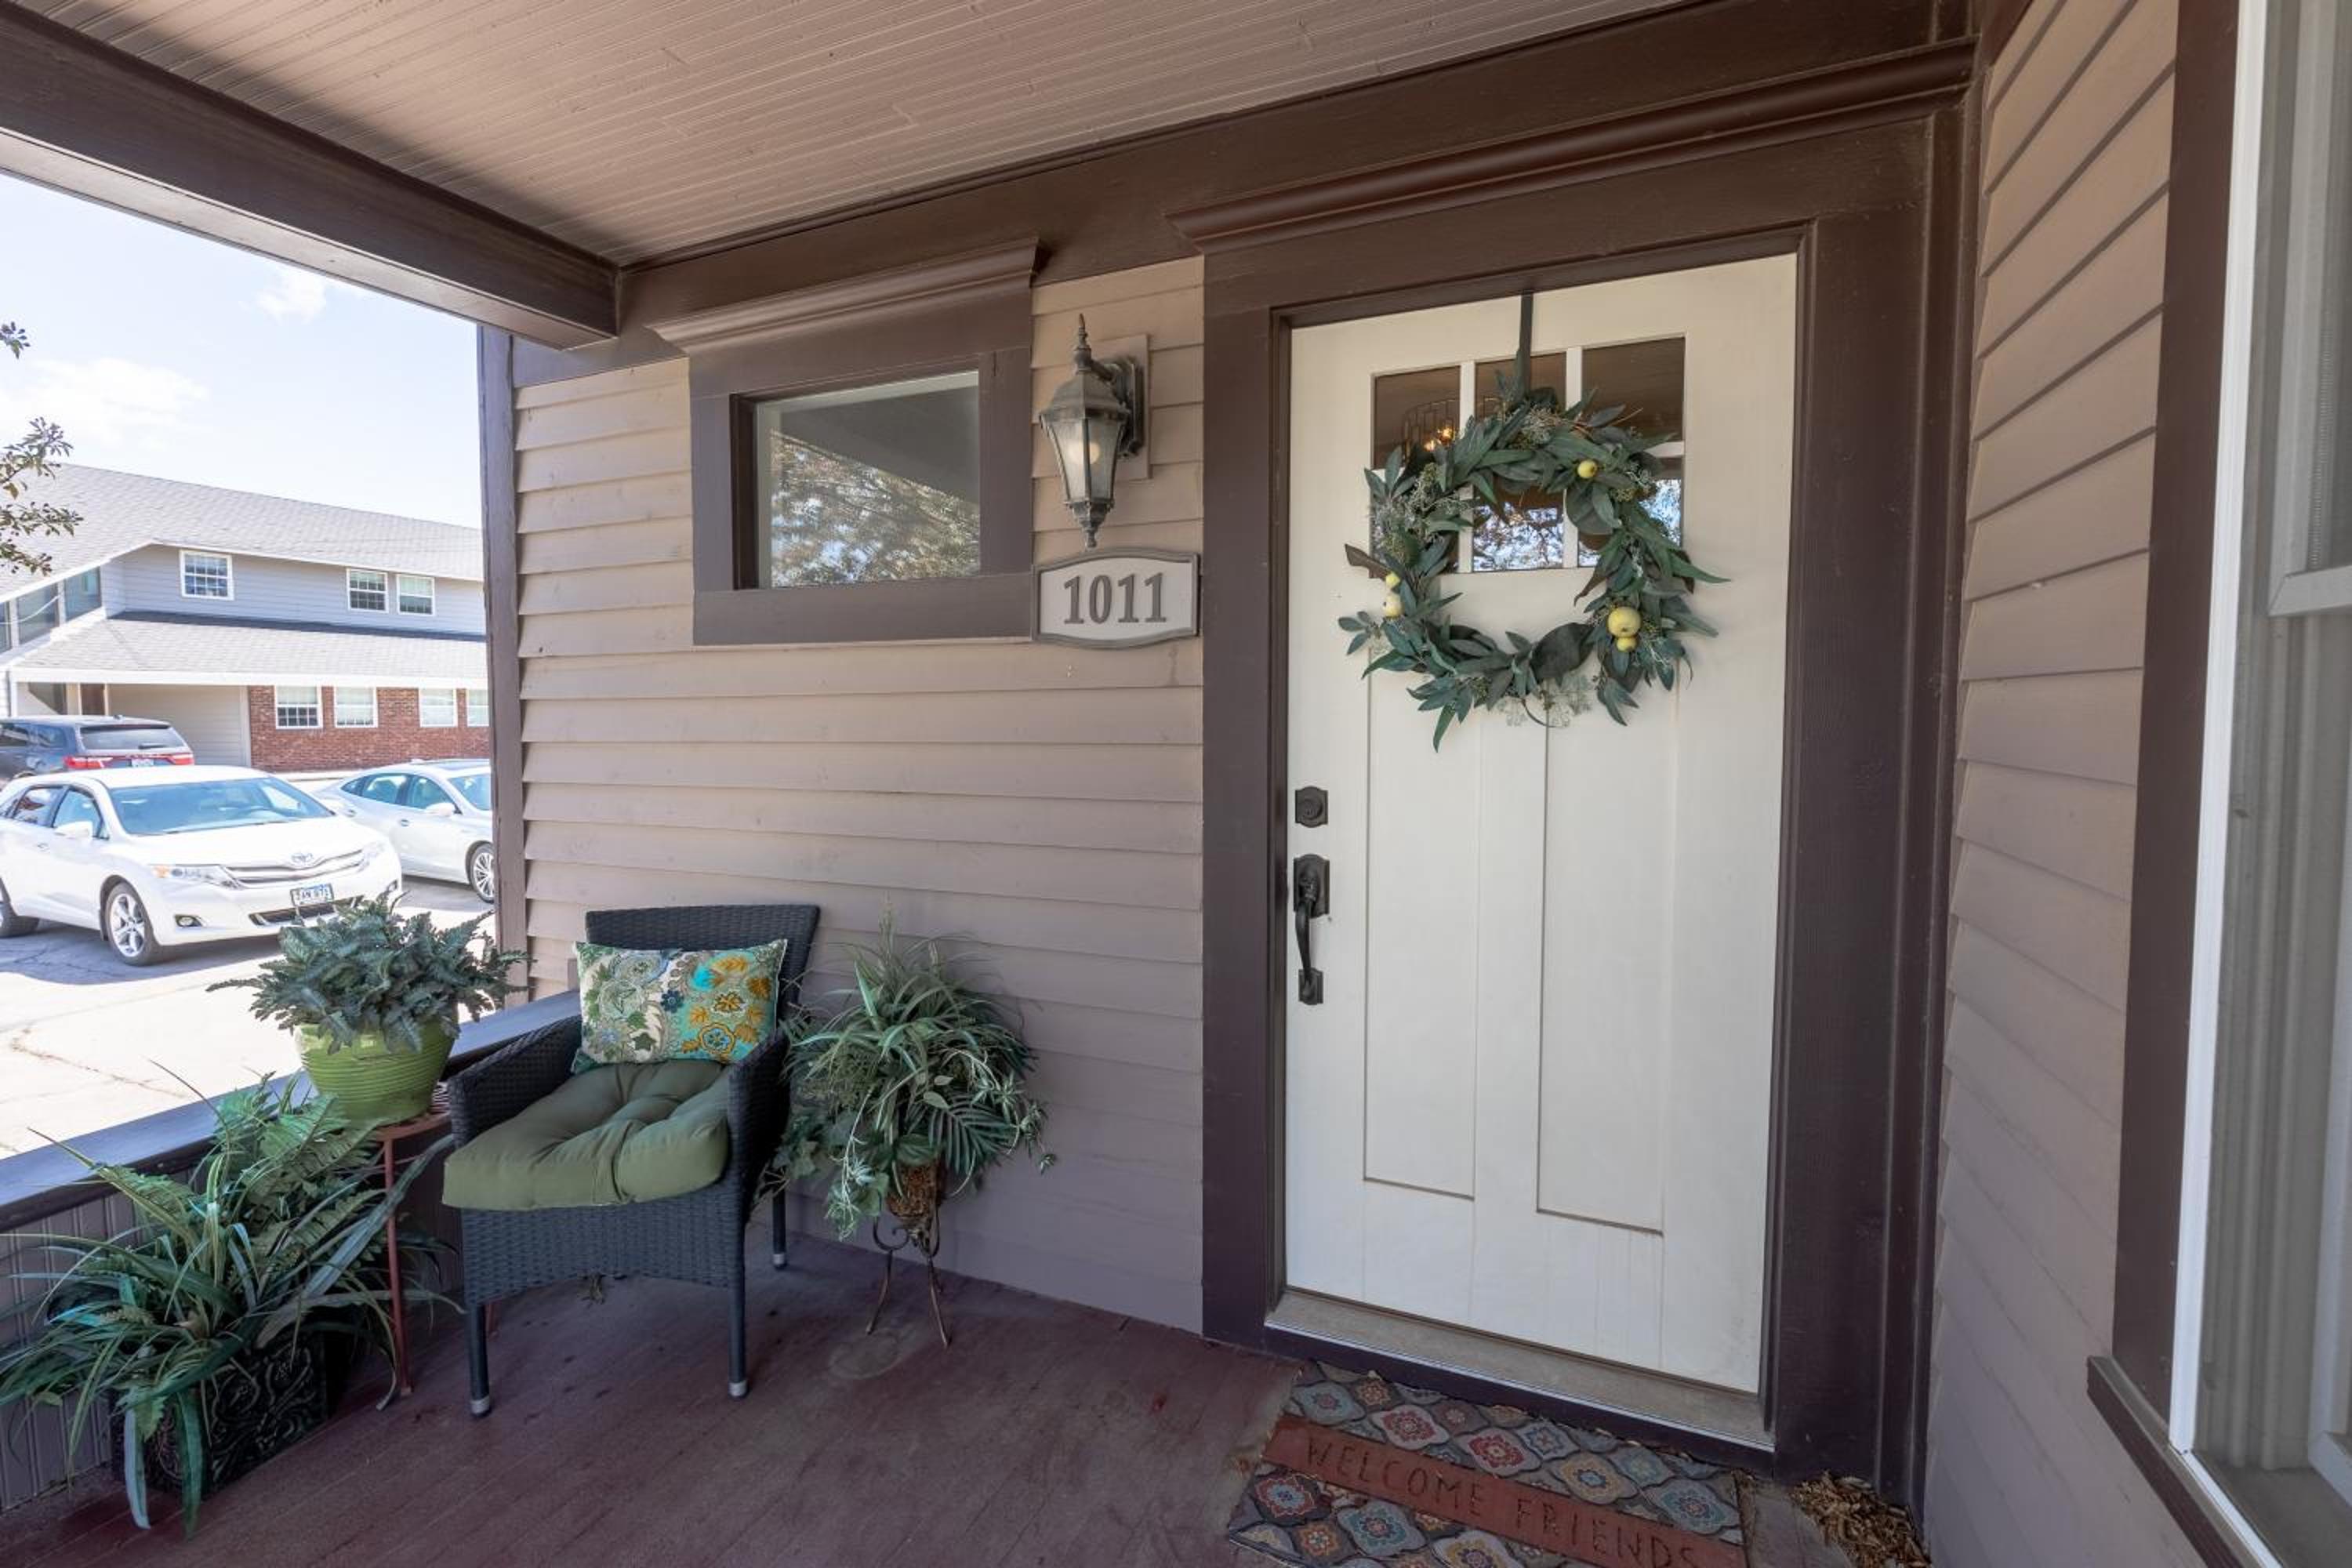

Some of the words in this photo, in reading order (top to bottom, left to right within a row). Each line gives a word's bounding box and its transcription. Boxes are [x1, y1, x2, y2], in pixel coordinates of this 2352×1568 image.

[1063, 572, 1167, 624] 1011
[1307, 1436, 1482, 1517] WELCOME
[1517, 1498, 1694, 1568] FRIENDS
